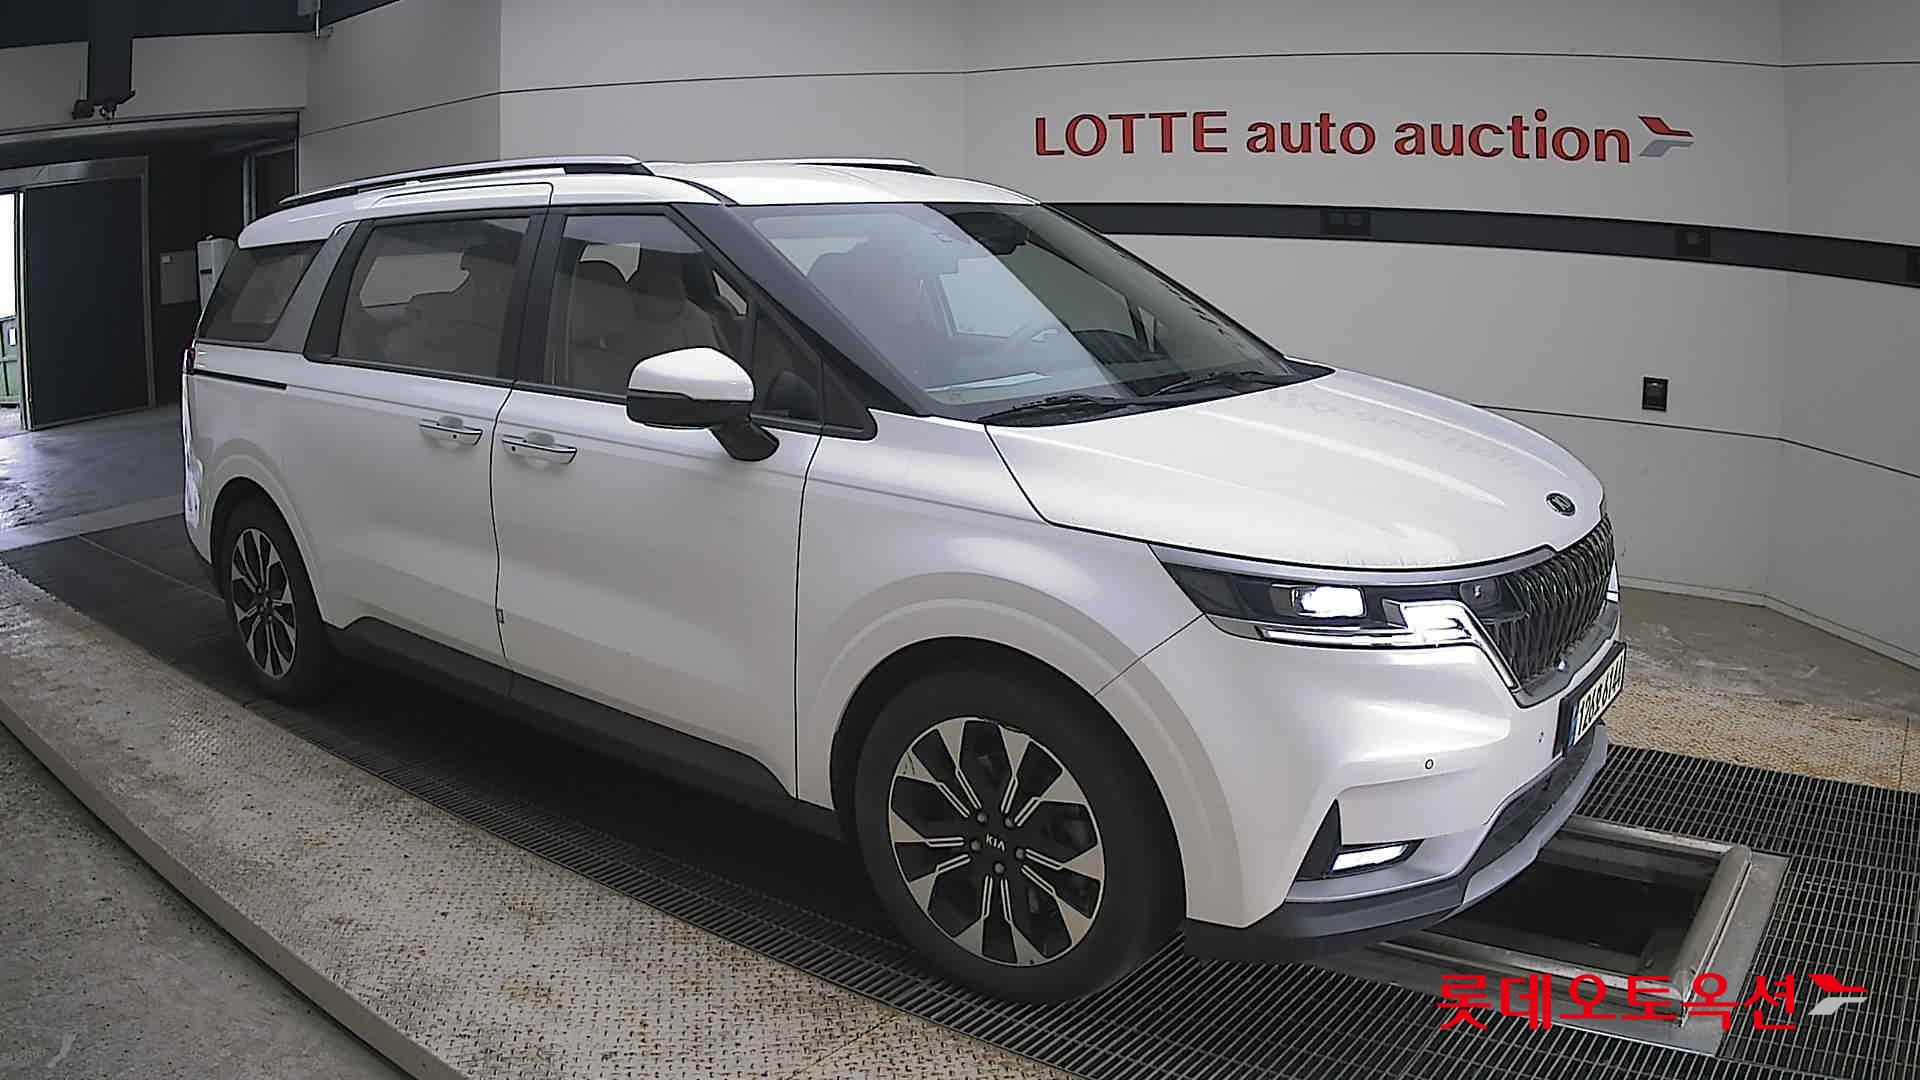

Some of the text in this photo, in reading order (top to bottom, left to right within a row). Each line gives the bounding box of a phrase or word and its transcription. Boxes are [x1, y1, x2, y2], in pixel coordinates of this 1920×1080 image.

[1035, 107, 1631, 164] LOTTE auto auction
[985, 833, 1006, 852] KIA
